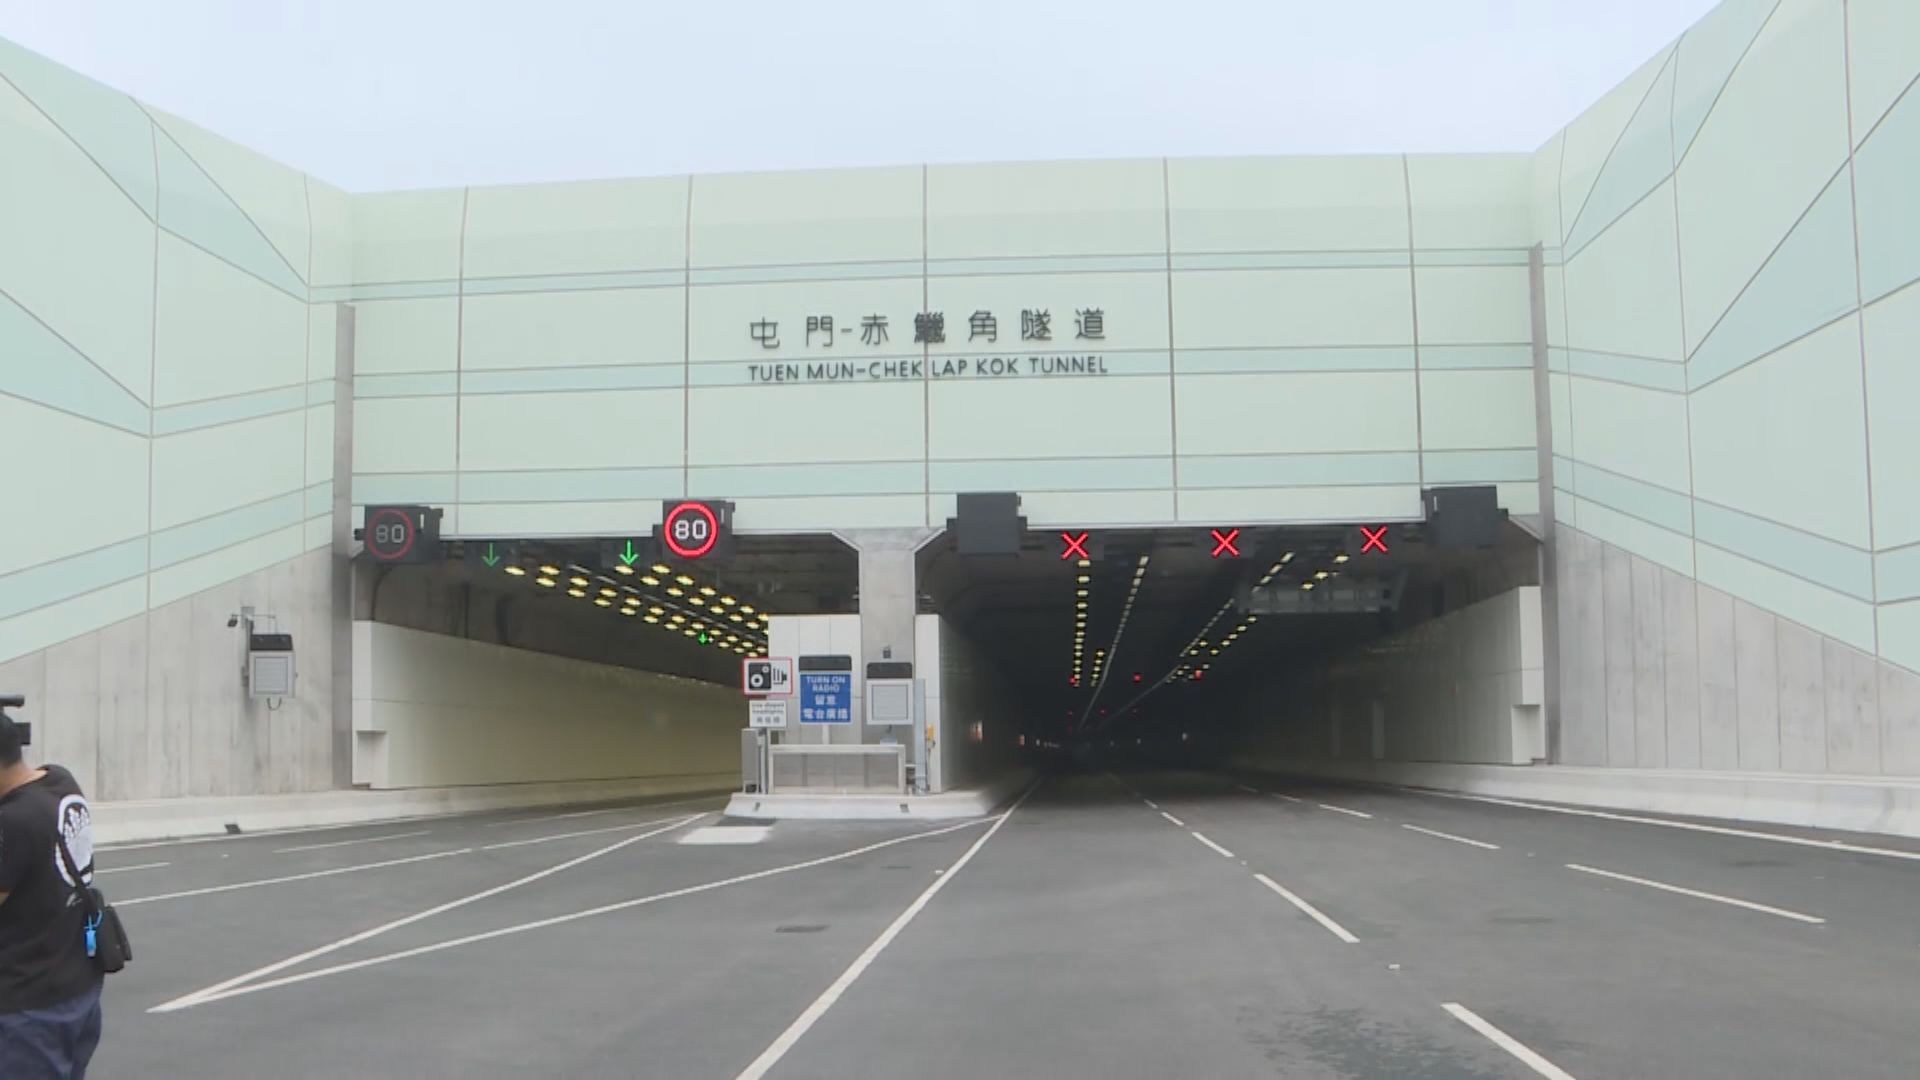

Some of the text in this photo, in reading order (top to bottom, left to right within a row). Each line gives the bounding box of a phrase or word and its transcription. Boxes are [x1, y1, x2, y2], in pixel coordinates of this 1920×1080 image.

[748, 356, 1108, 381] TUEN MUN-CHEK LAP KOK TUNNEL
[375, 524, 405, 544] 80
[675, 519, 707, 540] 80
[806, 675, 846, 684] TURN ON
[812, 684, 840, 693] RADIO
